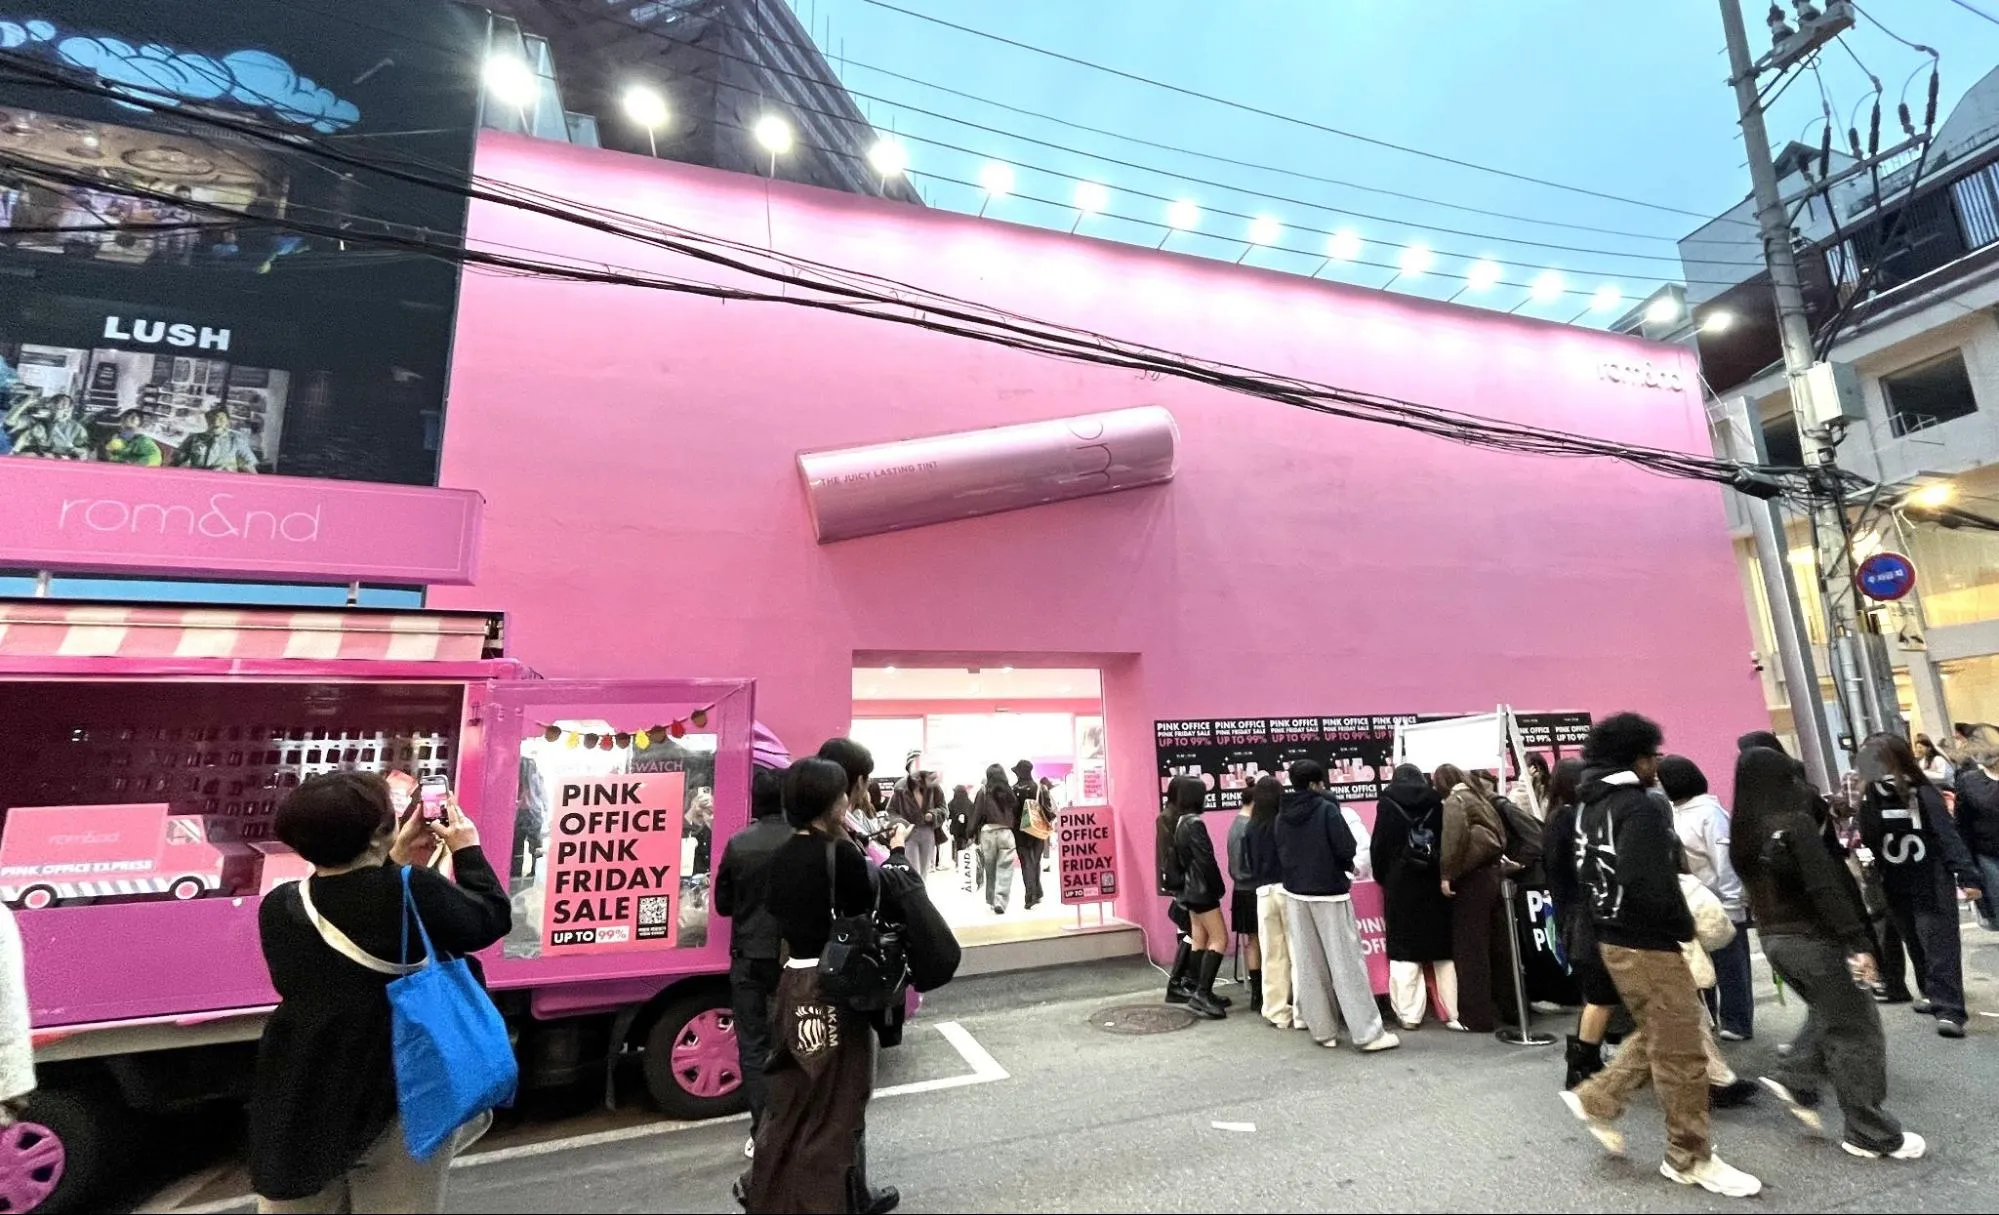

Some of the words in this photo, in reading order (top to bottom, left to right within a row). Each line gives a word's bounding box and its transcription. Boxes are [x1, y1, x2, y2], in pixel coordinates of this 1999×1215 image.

[104, 316, 231, 351] LUSH
[821, 477, 840, 486] THE
[844, 472, 871, 483] JUICY
[874, 464, 916, 478] LASTING
[918, 461, 938, 470] TINT
[59, 493, 320, 542] rom&nd
[1157, 722, 1180, 731] PINK
[1181, 722, 1210, 730] OFFICE
[1214, 721, 1236, 729] PINK
[1238, 720, 1265, 729] OFFICE
[1270, 719, 1290, 728] PINK
[1292, 718, 1318, 727] OFFICE
[1322, 718, 1342, 726] PINK
[1343, 717, 1369, 725] OFFICE
[1372, 717, 1391, 725] PINK
[1339, 732, 1350, 740] TO
[1351, 732, 1371, 740] 99%
[1374, 732, 1387, 740] UP
[1530, 726, 1550, 734] OFFICE
[1159, 738, 1173, 747] UP
[1175, 738, 1188, 746] TO
[1189, 737, 1212, 746] 99%
[1216, 736, 1230, 745] UP
[1231, 736, 1244, 744] TO
[1246, 735, 1267, 744] 99%
[1272, 734, 1285, 743] UP
[1286, 733, 1298, 742] TO
[1300, 733, 1320, 742] 99%
[1526, 735, 1535, 743] TO
[1567, 733, 1576, 741] TO
[562, 782, 643, 807] PINK
[1351, 784, 1377, 793] OFFICE
[1221, 792, 1242, 801] PINK
[559, 809, 667, 836] OFFICE
[1060, 813, 1096, 827] PINK
[1061, 827, 1108, 842] OFFICE
[557, 838, 639, 865] PINK
[1062, 842, 1097, 857] PINK
[1, 866, 38, 877] PINK
[41, 863, 90, 875] OFFICE
[1062, 856, 1112, 872] FRIDAY
[555, 865, 671, 894] FRIDAY
[1063, 872, 1097, 888] SALE
[553, 896, 630, 924] SALE
[553, 932, 573, 944] UP
[576, 930, 594, 942] TO
[598, 929, 626, 940] 99%
